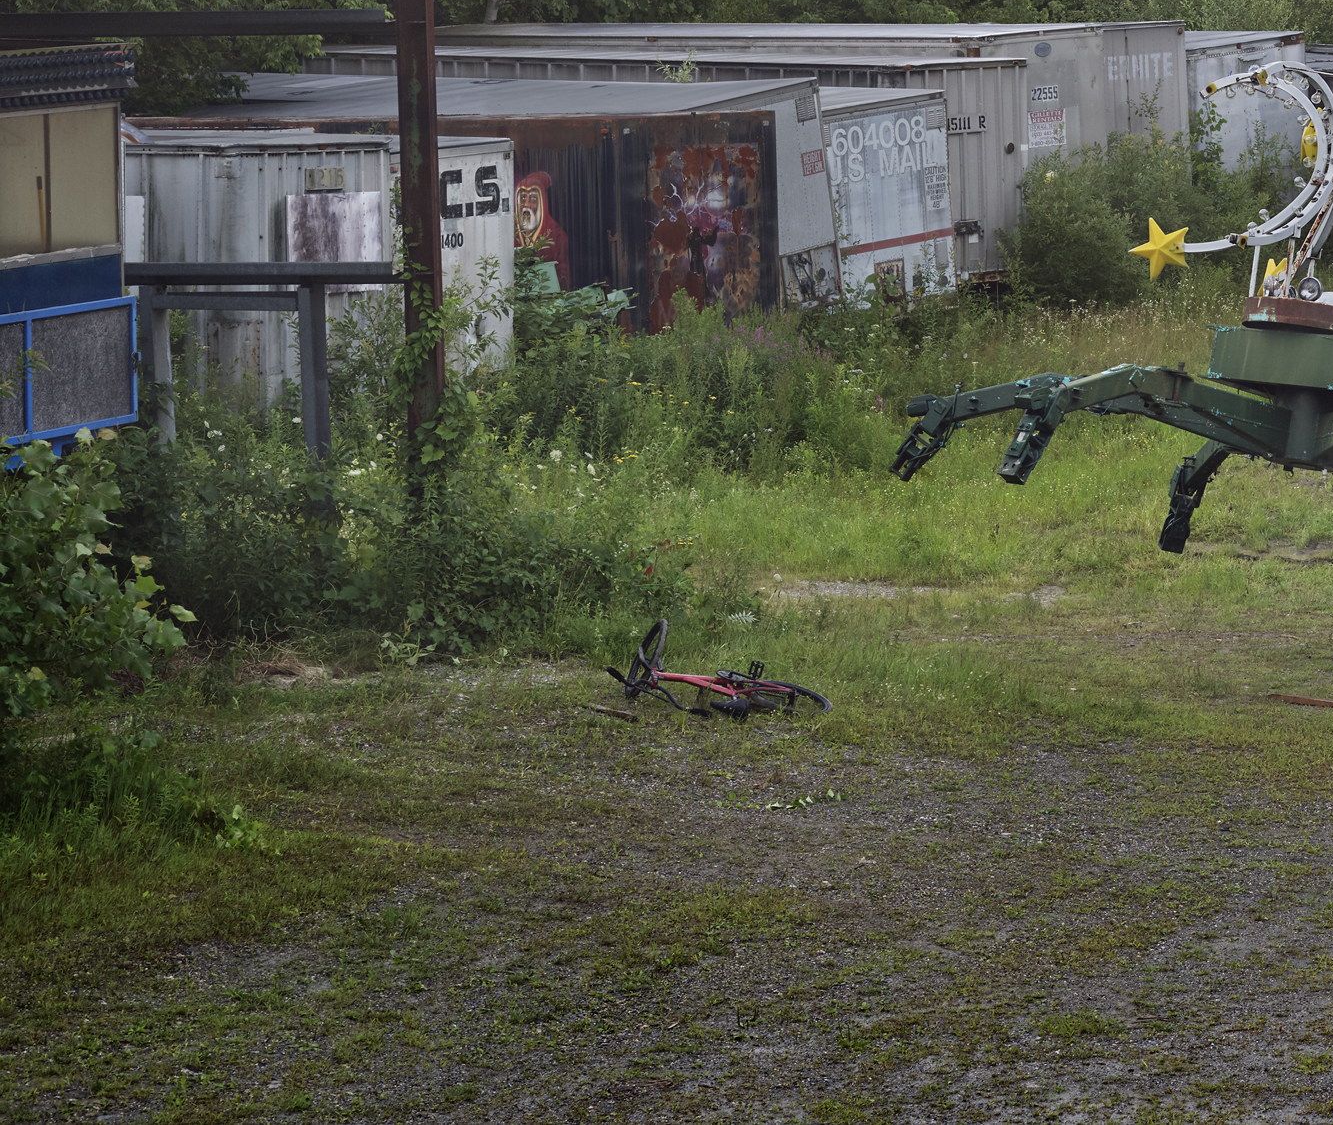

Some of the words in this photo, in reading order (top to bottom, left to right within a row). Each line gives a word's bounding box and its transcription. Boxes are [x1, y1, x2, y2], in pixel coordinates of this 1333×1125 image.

[1031, 85, 1058, 101] 22555
[832, 115, 926, 156] 604008
[878, 141, 937, 177] MAIL
